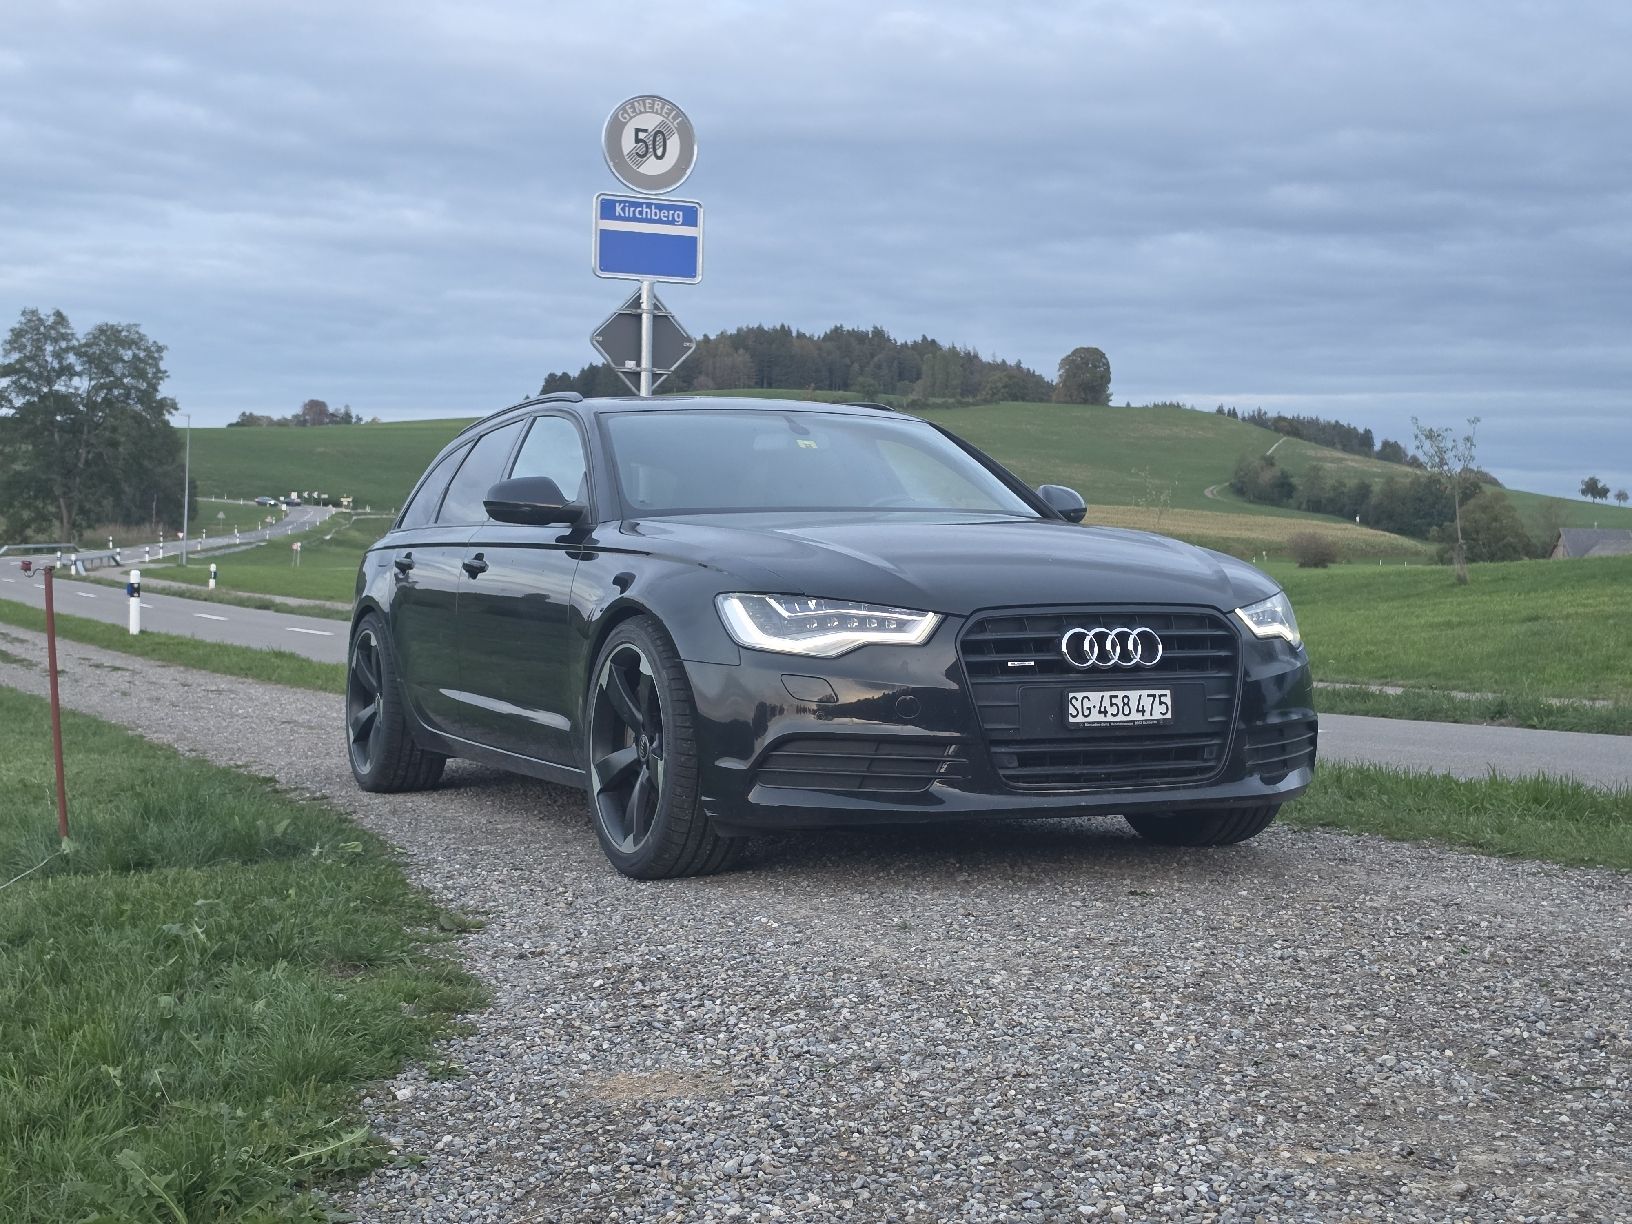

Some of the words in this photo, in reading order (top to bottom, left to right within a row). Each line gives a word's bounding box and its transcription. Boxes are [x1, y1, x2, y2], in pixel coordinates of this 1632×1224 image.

[618, 99, 683, 127] GENERELL
[634, 127, 667, 161] 50
[615, 202, 684, 225] Kirchberg
